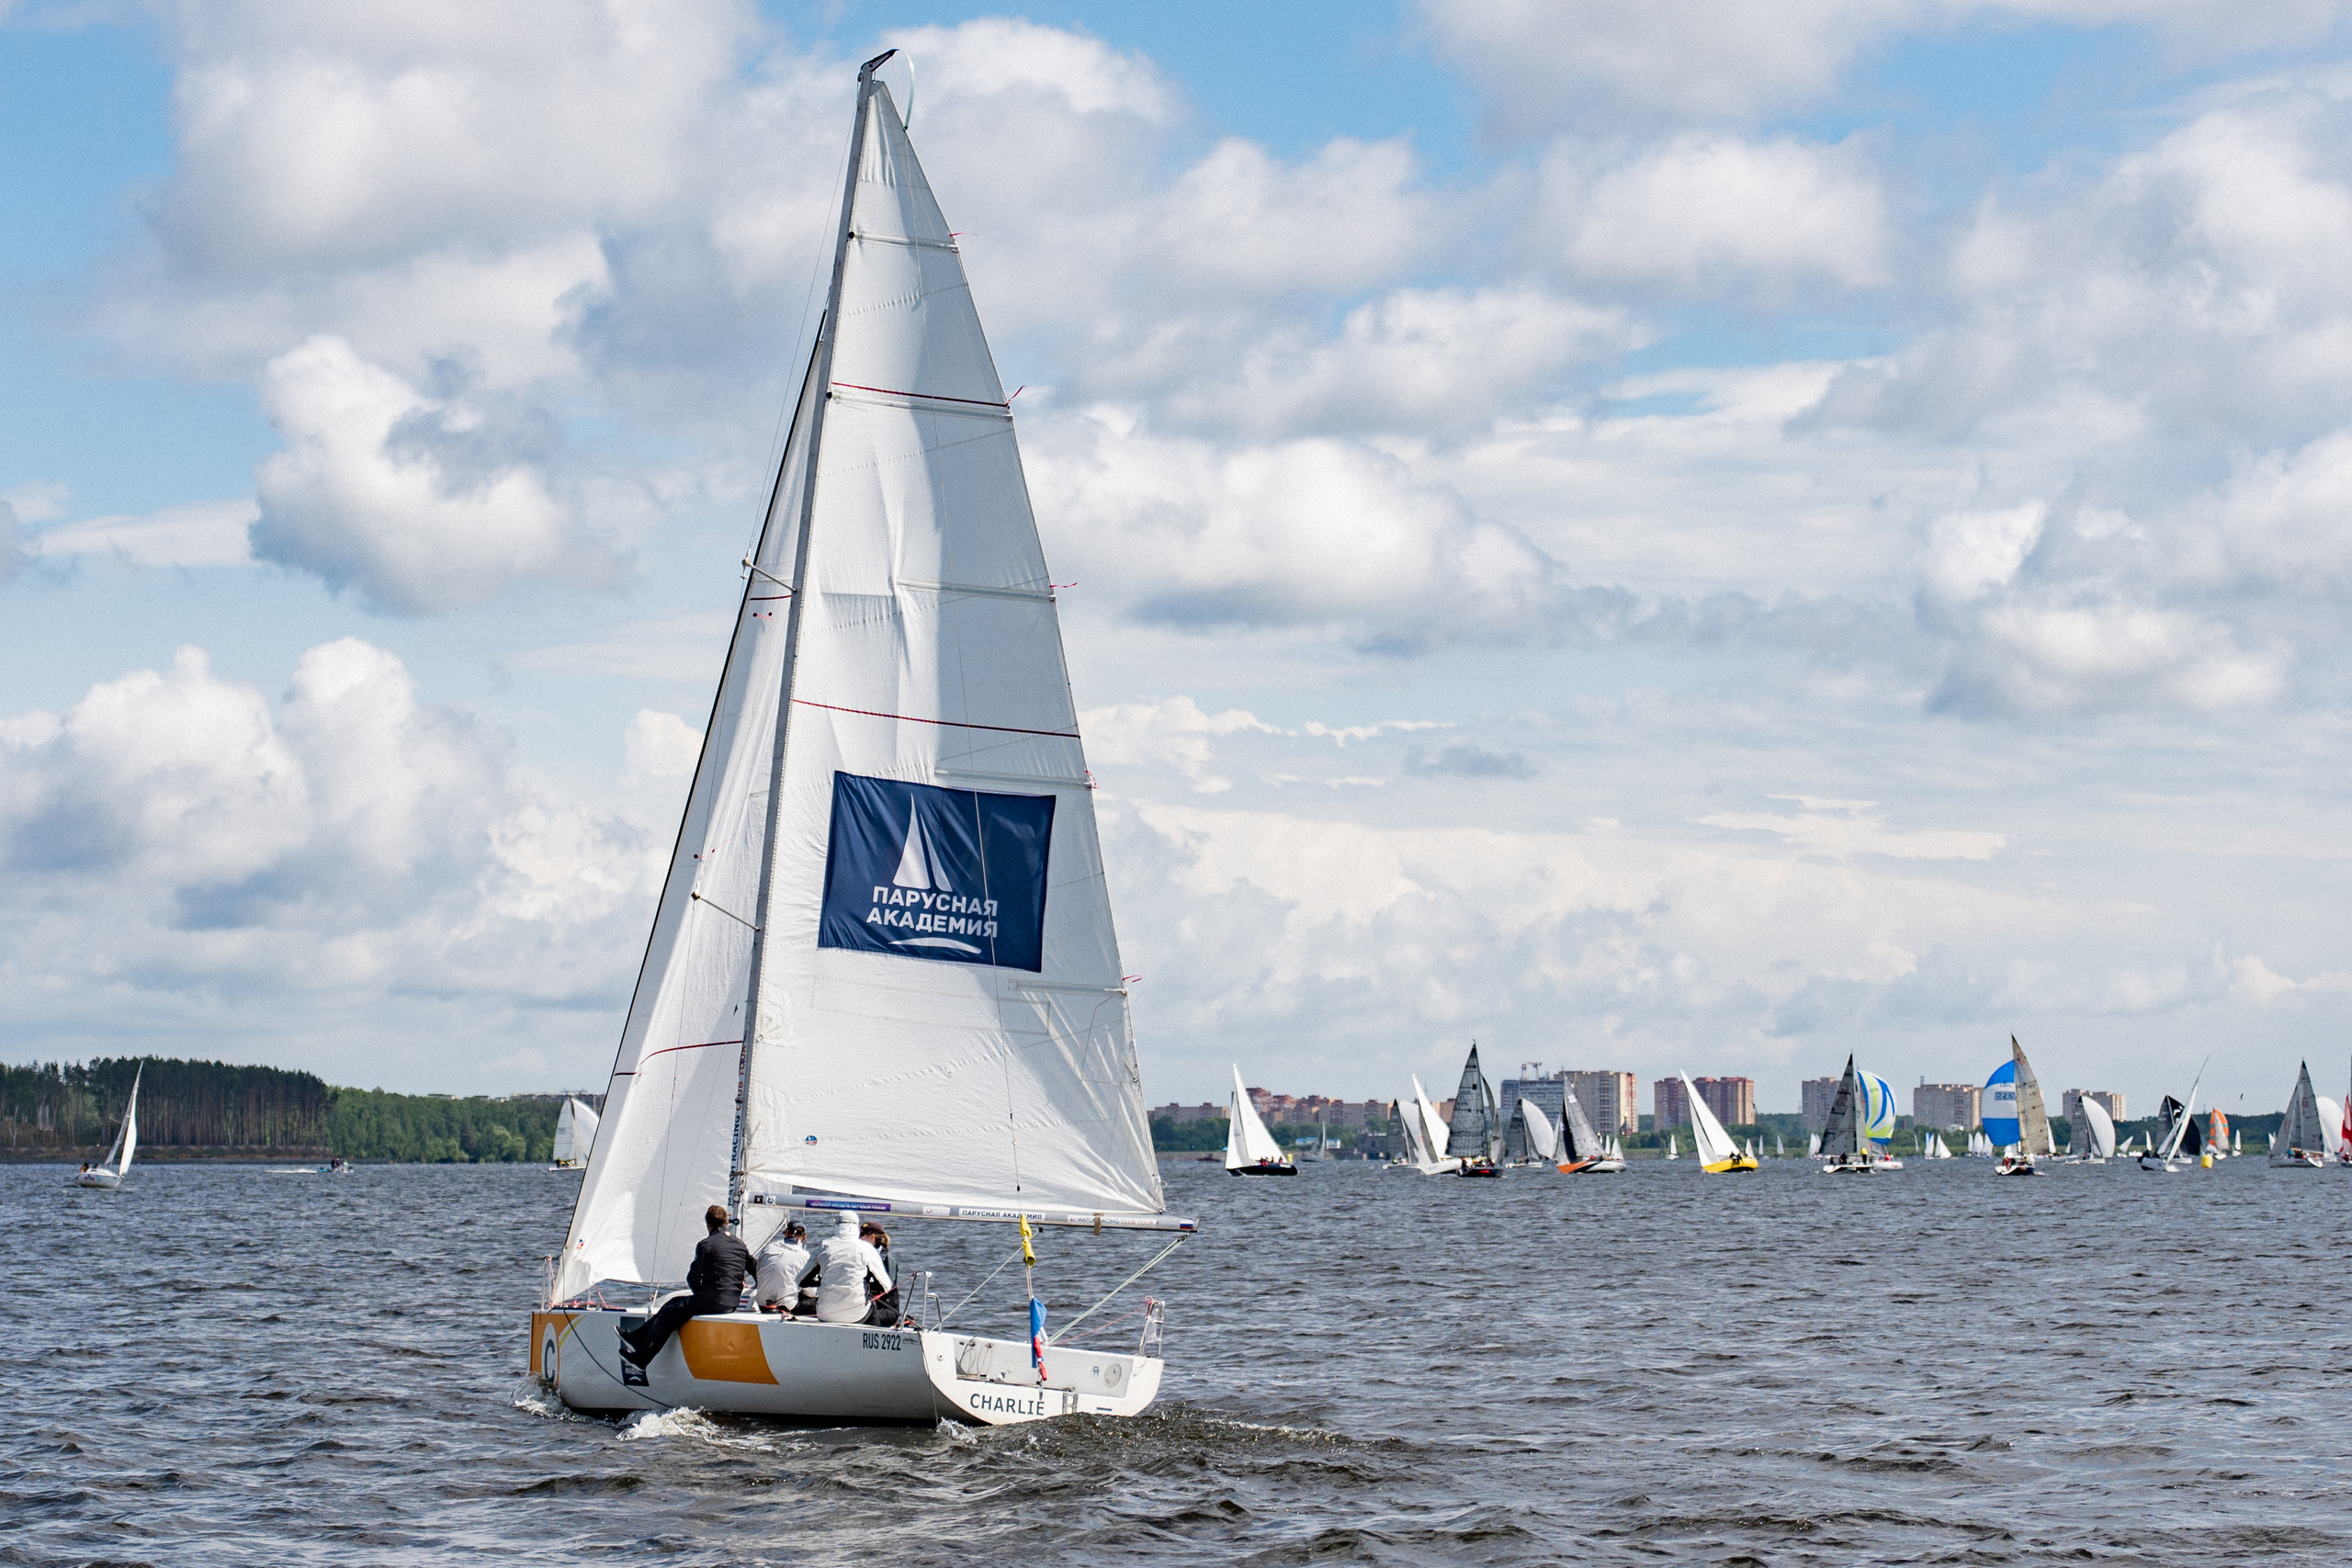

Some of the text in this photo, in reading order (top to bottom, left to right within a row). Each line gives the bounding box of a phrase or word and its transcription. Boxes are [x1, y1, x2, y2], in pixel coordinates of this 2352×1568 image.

[872, 886, 998, 917] ПАРУСНАЯ
[866, 908, 998, 938] АКАДЕМИЯ
[731, 1115, 741, 1161] RACING
[962, 1210, 1042, 1220] ПАРУСНАЯ АКАДМИЯ
[863, 1333, 901, 1350] RUS 2922
[544, 1338, 555, 1382] C
[969, 1393, 1046, 1416] CHARLIE
